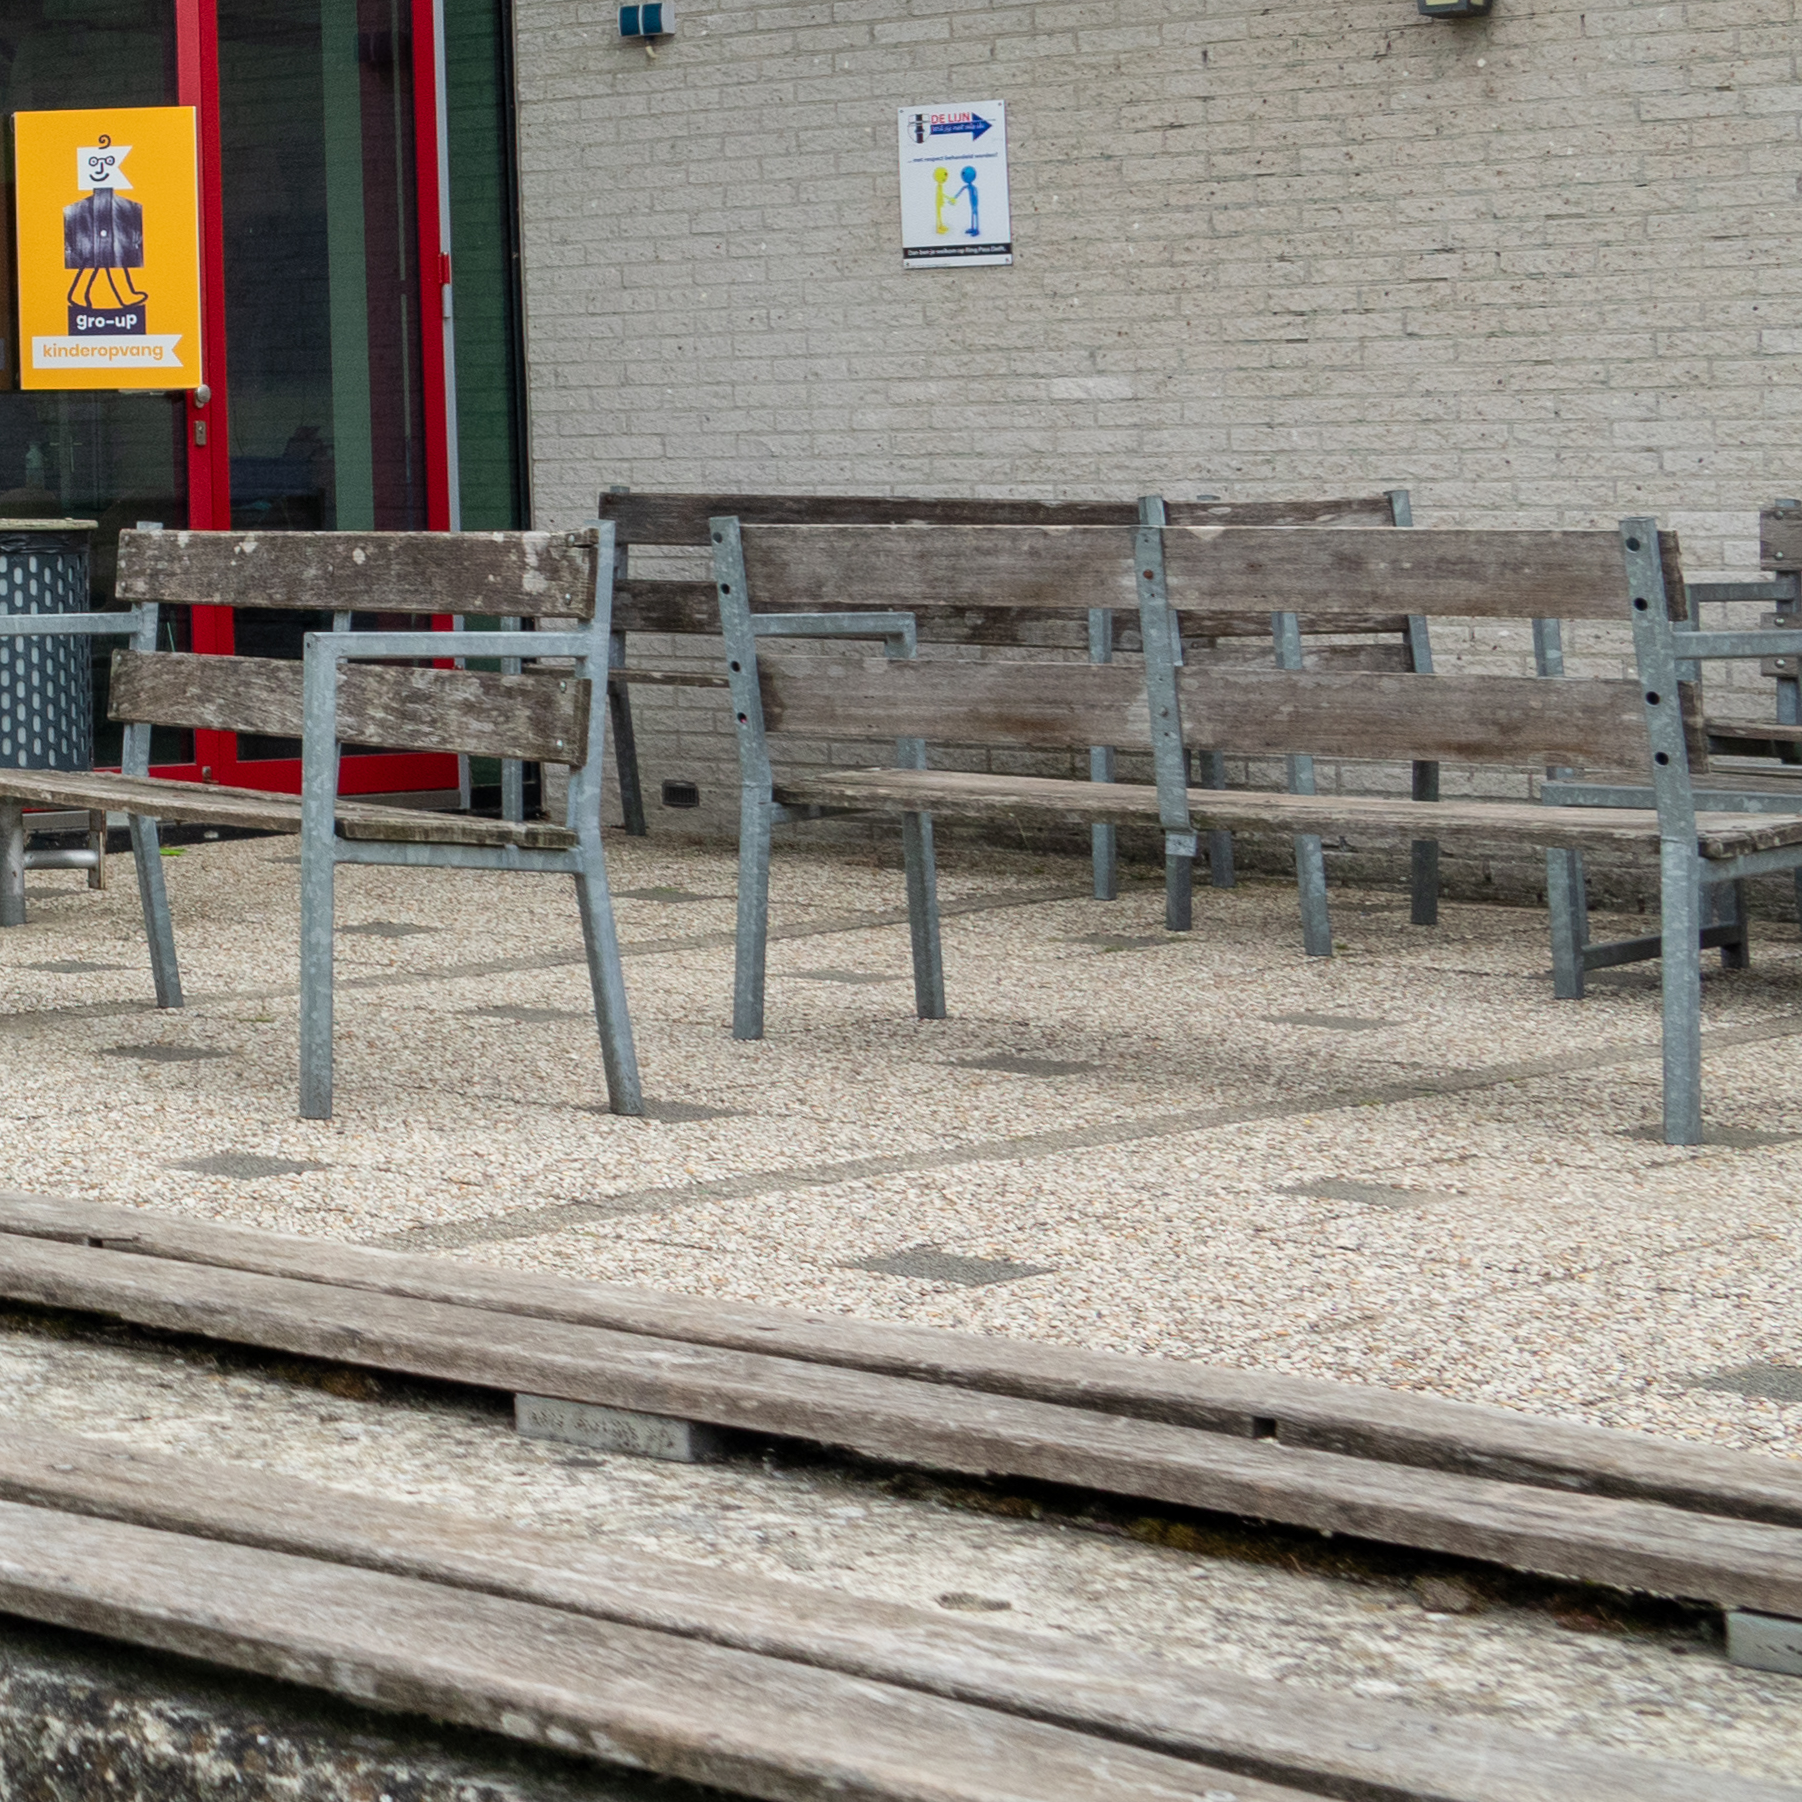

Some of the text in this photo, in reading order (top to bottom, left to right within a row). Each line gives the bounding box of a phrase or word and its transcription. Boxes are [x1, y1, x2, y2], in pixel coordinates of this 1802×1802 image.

[931, 112, 970, 124] DE LIJN
[76, 313, 138, 330] gro-up
[42, 343, 164, 362] kinderopvang
